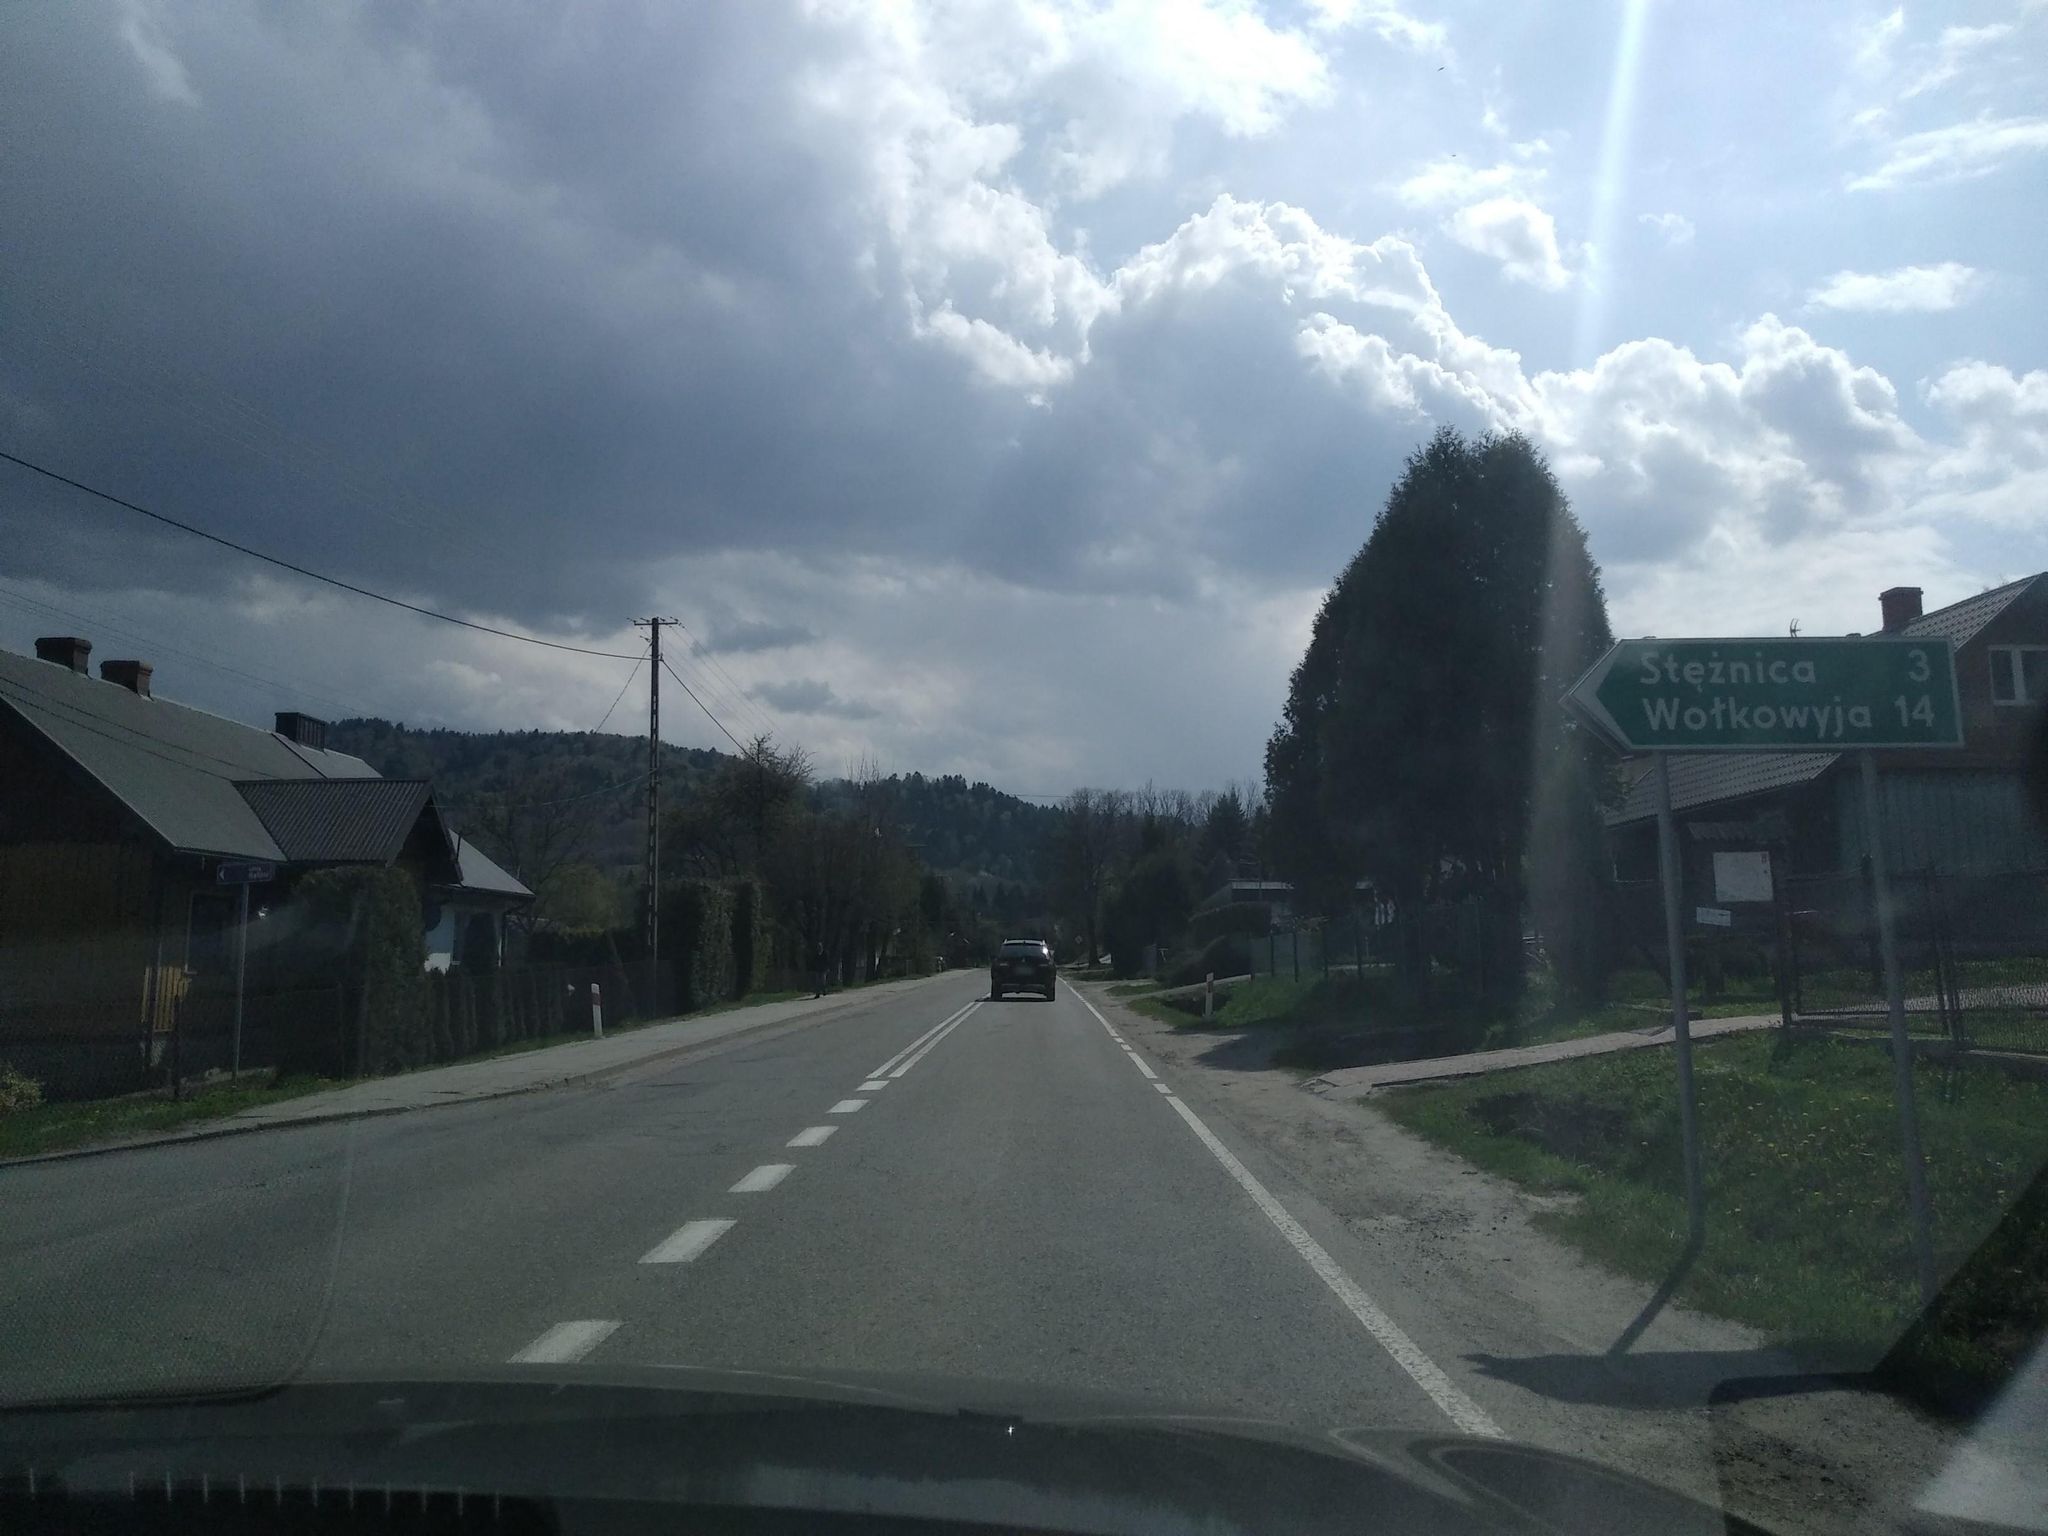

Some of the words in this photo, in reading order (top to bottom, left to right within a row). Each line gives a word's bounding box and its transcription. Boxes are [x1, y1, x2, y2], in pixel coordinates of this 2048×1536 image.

[1639, 651, 1816, 692] Stężnica
[1908, 649, 1930, 682] 3
[1642, 695, 1872, 738] Wołkowyja
[1895, 695, 1935, 727] 14
